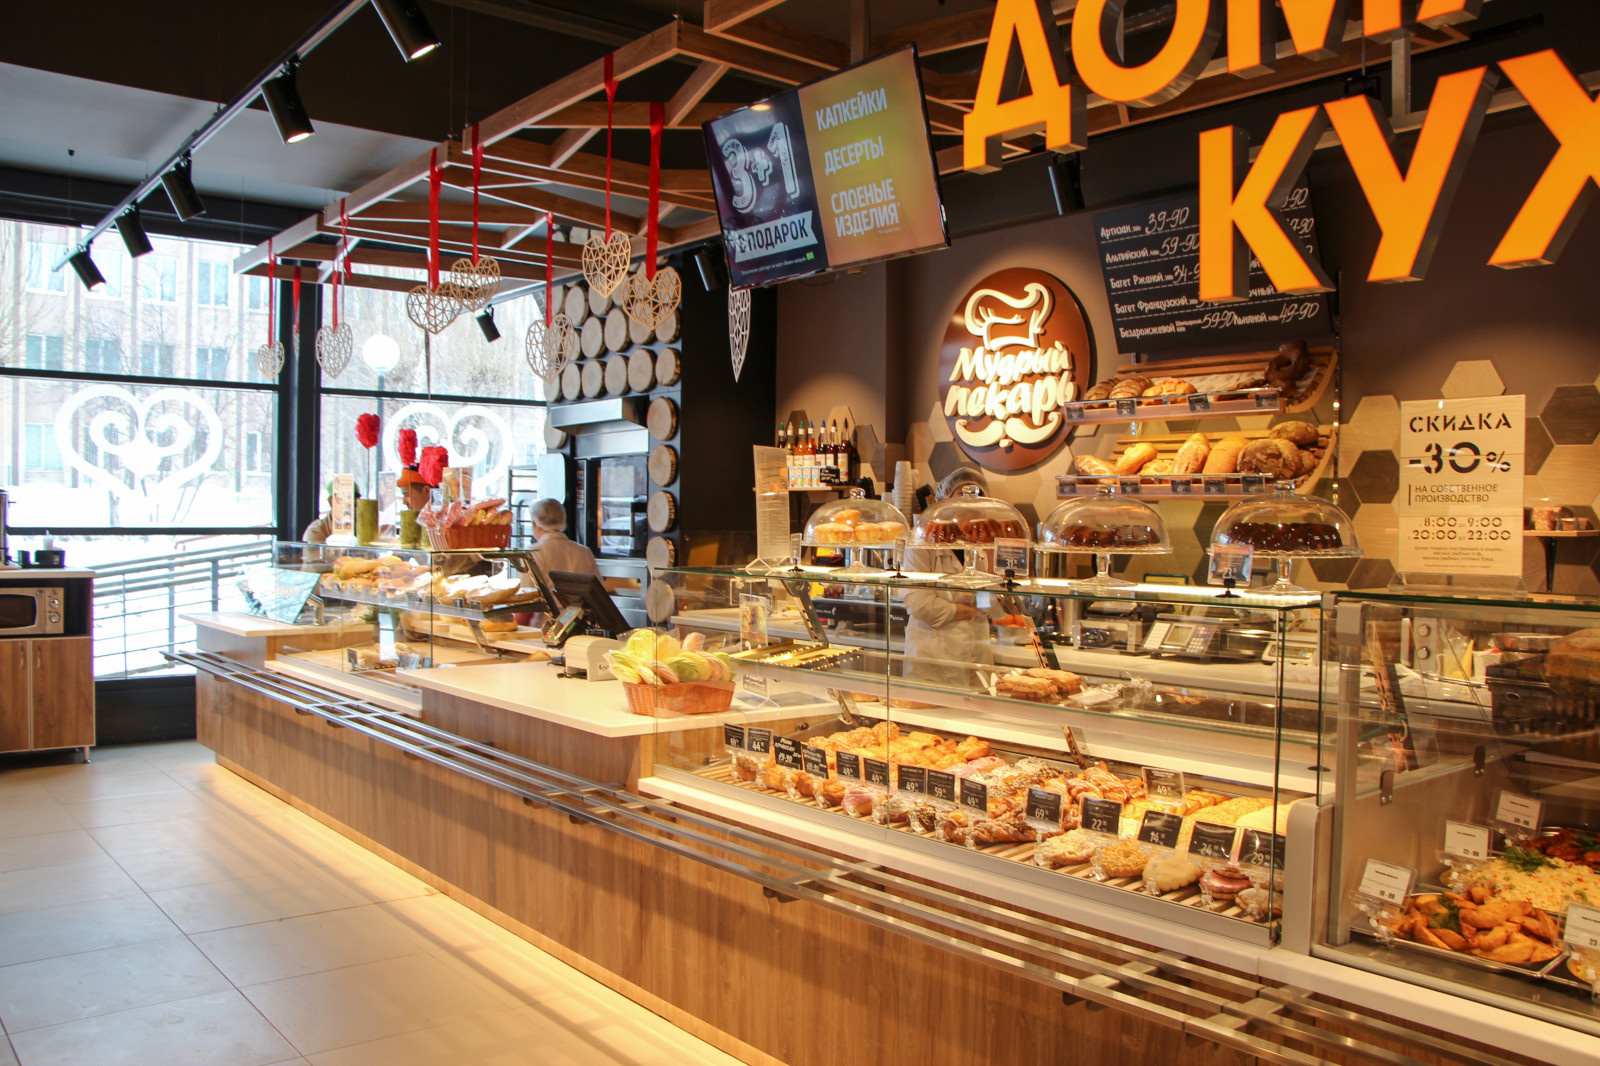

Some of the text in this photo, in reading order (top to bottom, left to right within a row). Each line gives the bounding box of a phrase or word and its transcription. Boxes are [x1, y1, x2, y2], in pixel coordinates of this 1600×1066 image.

[816, 88, 888, 131] КАПКЕЙКИ
[722, 122, 800, 213] 3+1
[825, 136, 884, 176] ДЕСЕРТЫ
[831, 178, 896, 214] СЛОЕНЫЕ
[747, 217, 808, 252] ПОДАРОК
[1101, 225, 1130, 239] Артизан
[1145, 206, 1189, 235] 39-90
[1110, 278, 1131, 289] Багет
[1133, 272, 1164, 285] Ржаной
[1114, 303, 1136, 314] Багет
[1137, 295, 1188, 313] Французский
[1279, 302, 1320, 324] 49-90
[949, 341, 1073, 385] Мудрый
[945, 371, 1077, 426] пекарь
[1409, 412, 1512, 433] СКИДКА
[1409, 441, 1511, 475] -30%
[1415, 484, 1498, 493] НА СОБСТВЕННОЕ
[1415, 494, 1490, 503] ПРОИЗВОДСТВО
[1412, 530, 1457, 540] 20:00
[1467, 530, 1511, 541] 22:00
[1424, 517, 1457, 527] 8:00
[1467, 517, 1502, 528] 9:00
